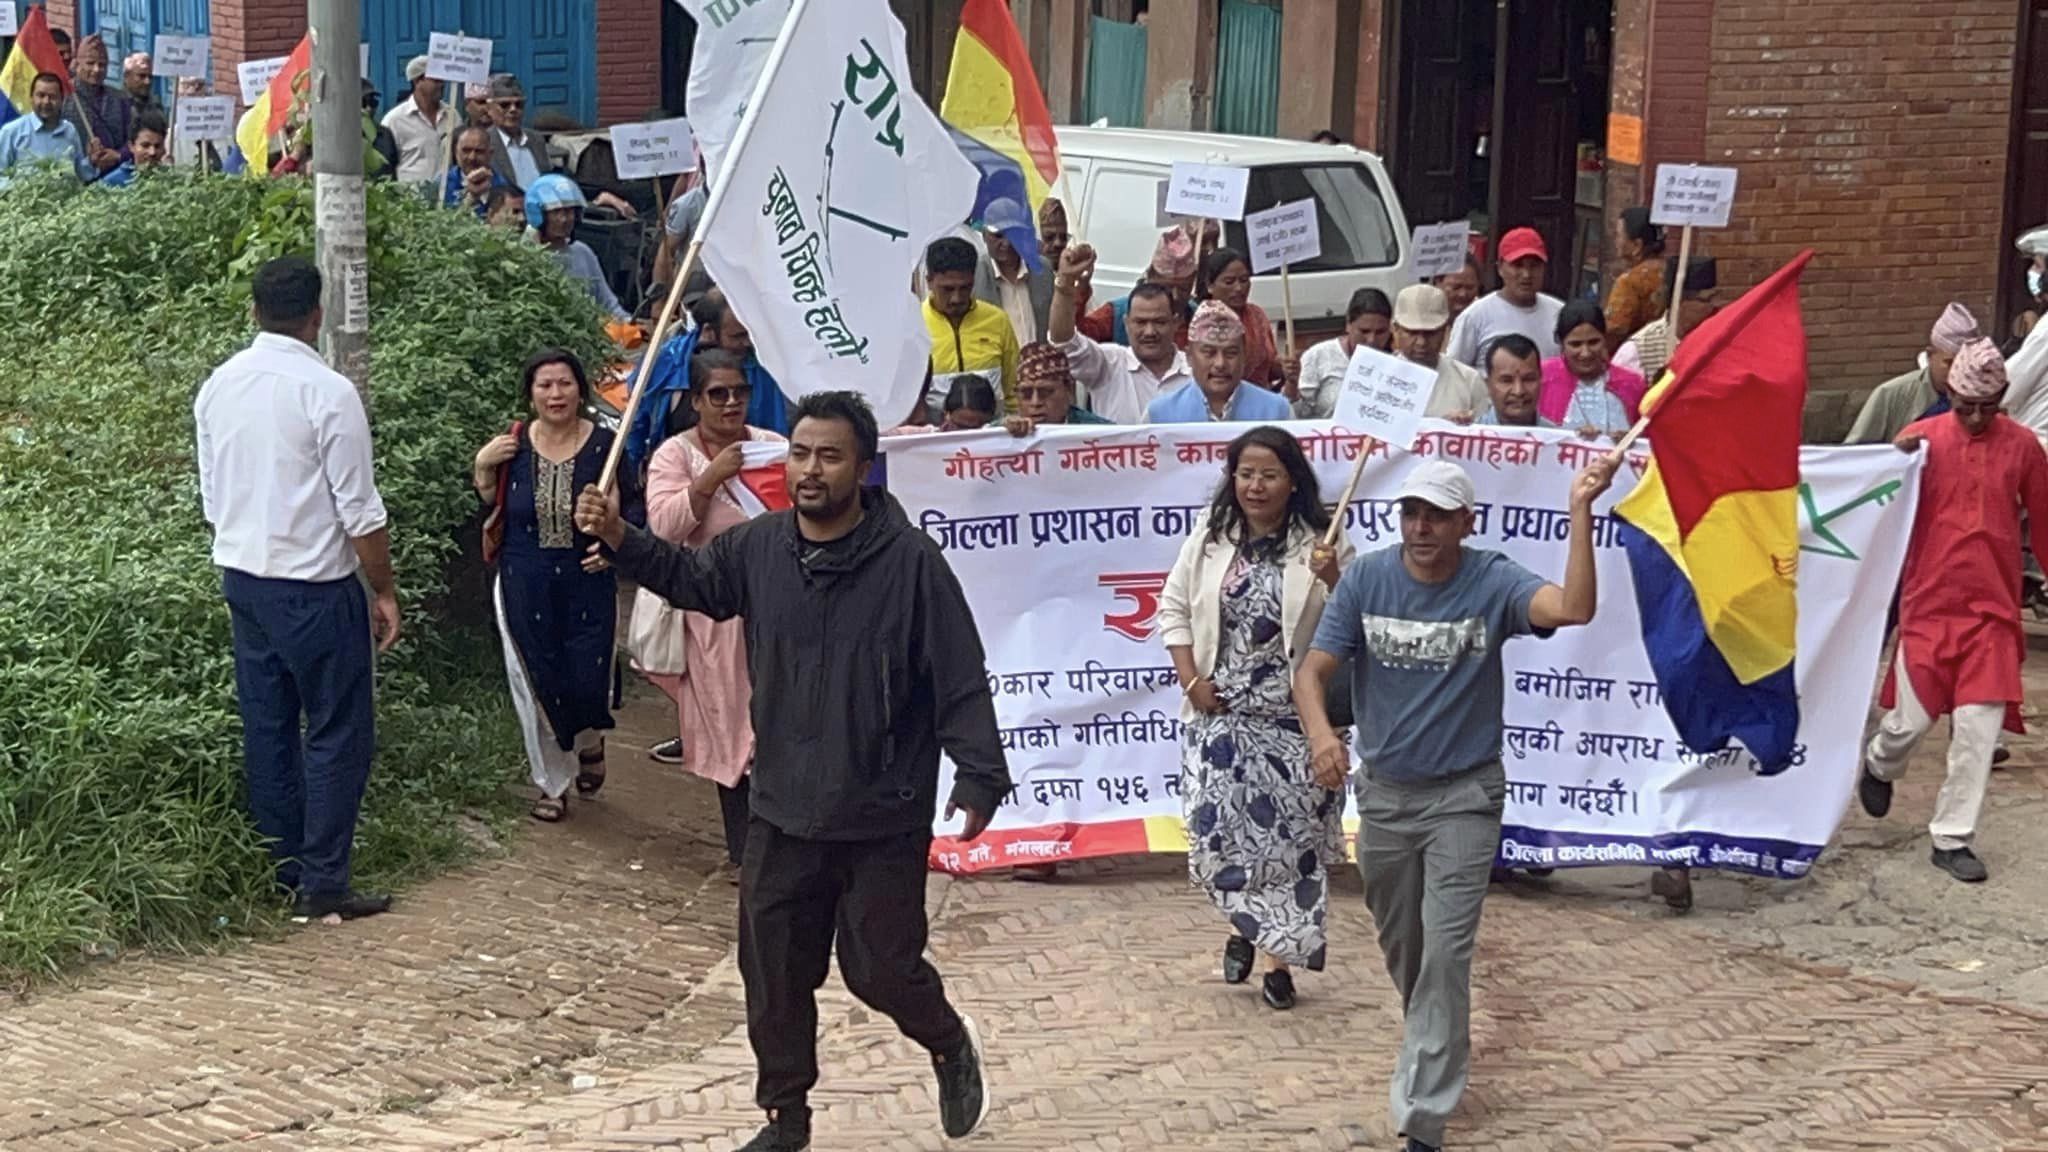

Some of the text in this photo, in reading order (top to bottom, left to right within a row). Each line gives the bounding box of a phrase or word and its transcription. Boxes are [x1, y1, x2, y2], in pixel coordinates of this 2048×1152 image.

[762, 165, 806, 246] चुनाव
[943, 447, 1044, 482] गौहत्या
[1059, 434, 1161, 473] गर्नेलाई
[920, 508, 1020, 550] जिल्ला
[1029, 506, 1142, 548] प्रशासन
[1515, 667, 1616, 701] बमोजिम
[1072, 709, 1186, 747] गतिविधि
[1576, 731, 1664, 763] अपराध
[1031, 777, 1084, 806] दफा
[1096, 774, 1150, 805] १५६
